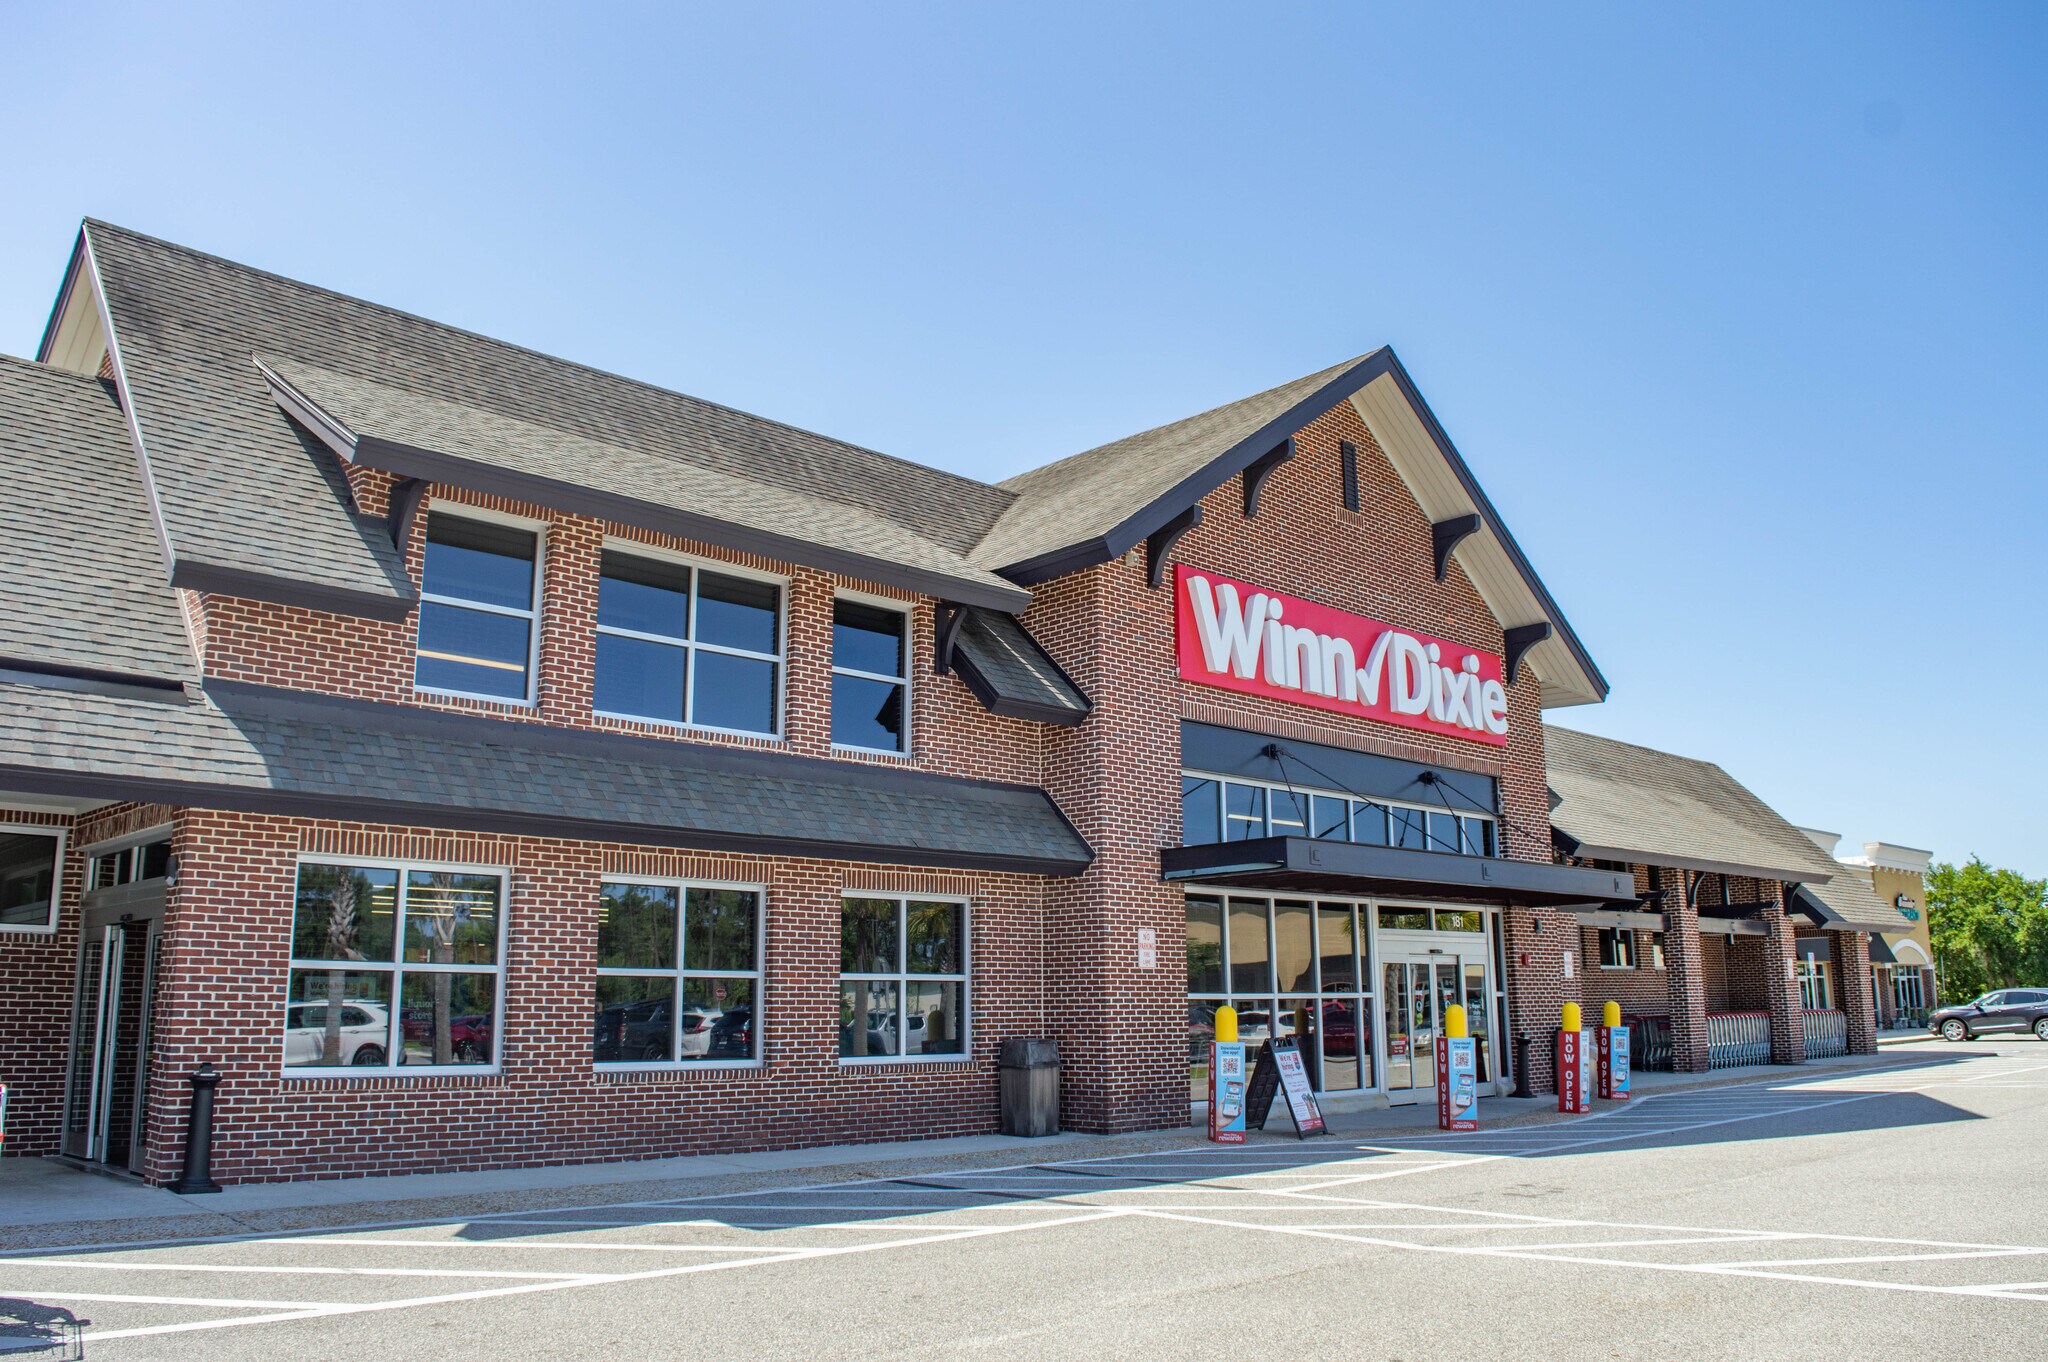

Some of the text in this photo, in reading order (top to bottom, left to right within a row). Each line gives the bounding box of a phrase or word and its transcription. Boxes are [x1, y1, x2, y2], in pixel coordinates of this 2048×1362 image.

[1186, 575, 1509, 735] Winn Dixie
[1452, 916, 1464, 928] 181
[1143, 933, 1151, 941] NO
[310, 982, 332, 990] We're
[407, 998, 433, 1010] liquor
[408, 1011, 433, 1020] store
[1600, 1028, 1608, 1055] NOW
[1279, 1053, 1291, 1061] We're
[1439, 1041, 1447, 1074] NOW
[1280, 1062, 1295, 1072] hiring
[1563, 1033, 1575, 1111] NOW OPEN
